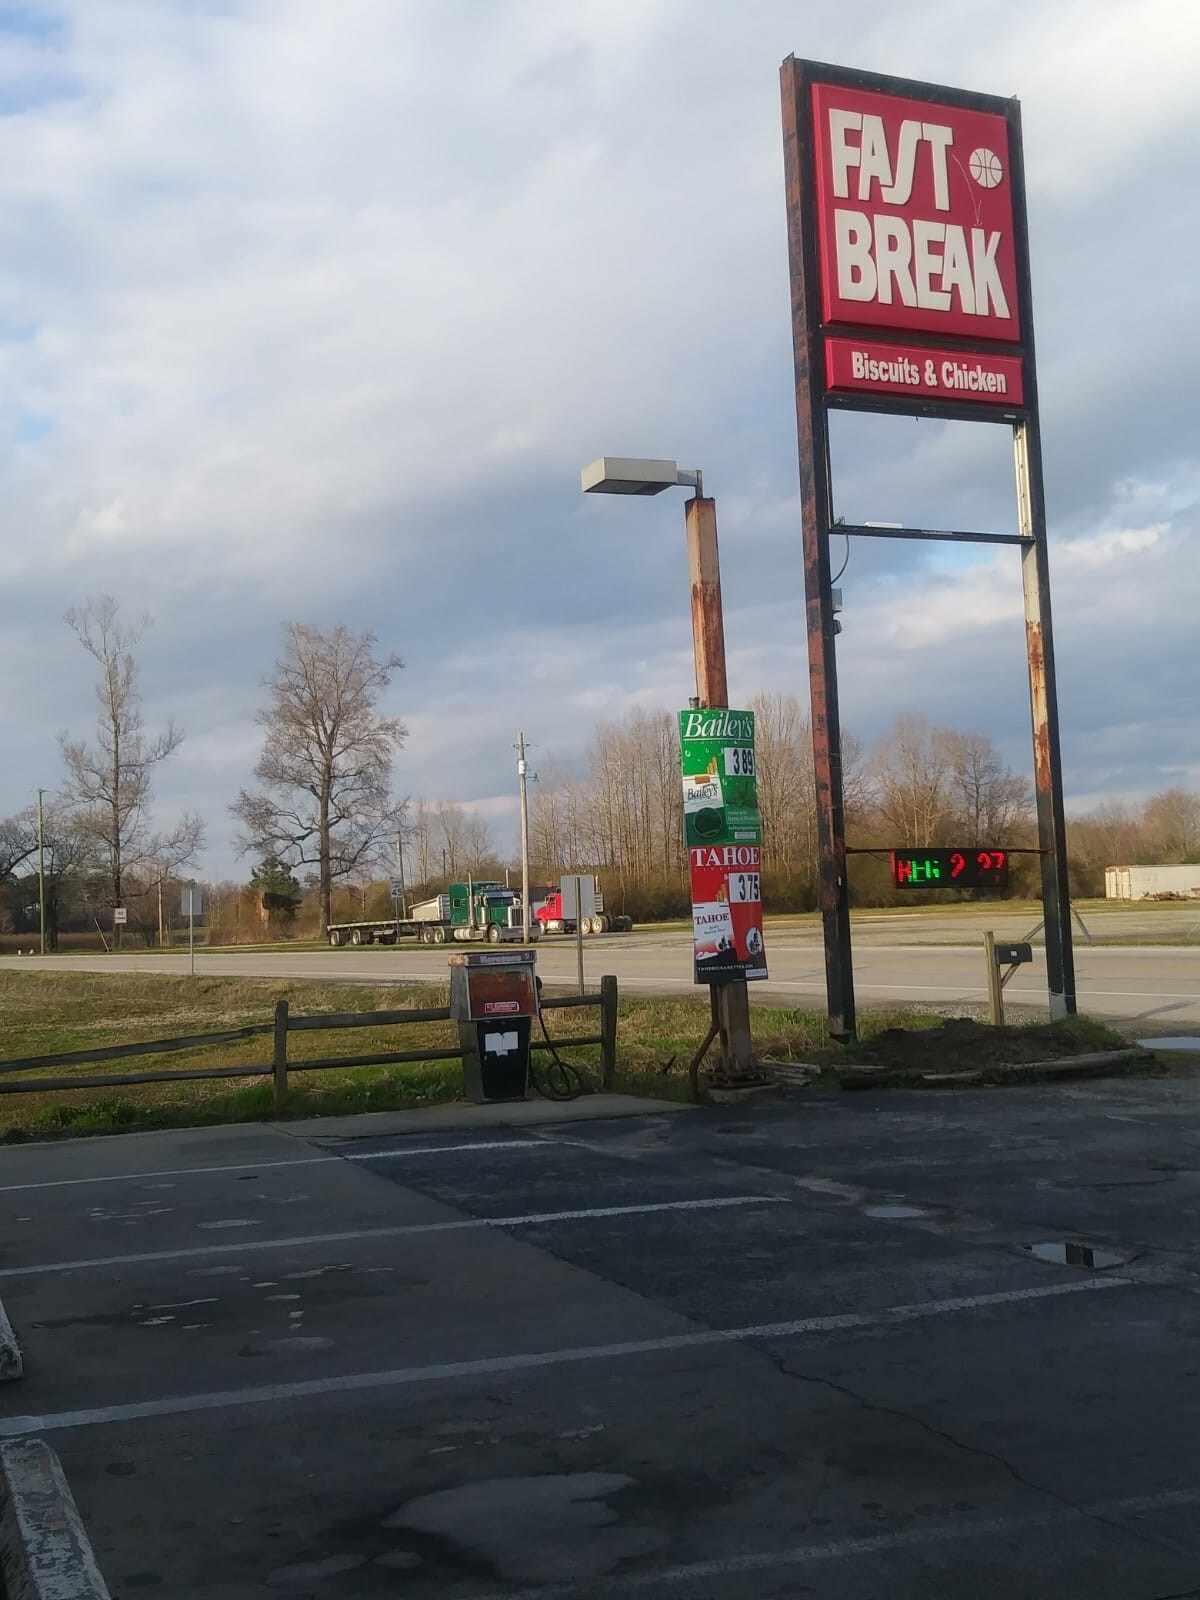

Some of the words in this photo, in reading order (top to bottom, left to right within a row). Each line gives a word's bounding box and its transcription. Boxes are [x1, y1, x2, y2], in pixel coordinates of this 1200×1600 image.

[828, 107, 954, 212] FAST
[834, 208, 1011, 319] BREAK
[852, 351, 920, 385] Biscuits
[924, 359, 938, 387] &
[941, 361, 1007, 394] Chicken
[691, 845, 760, 867] TAHOE
[391, 888, 403, 897] 45
[694, 912, 730, 925] TAHOE
